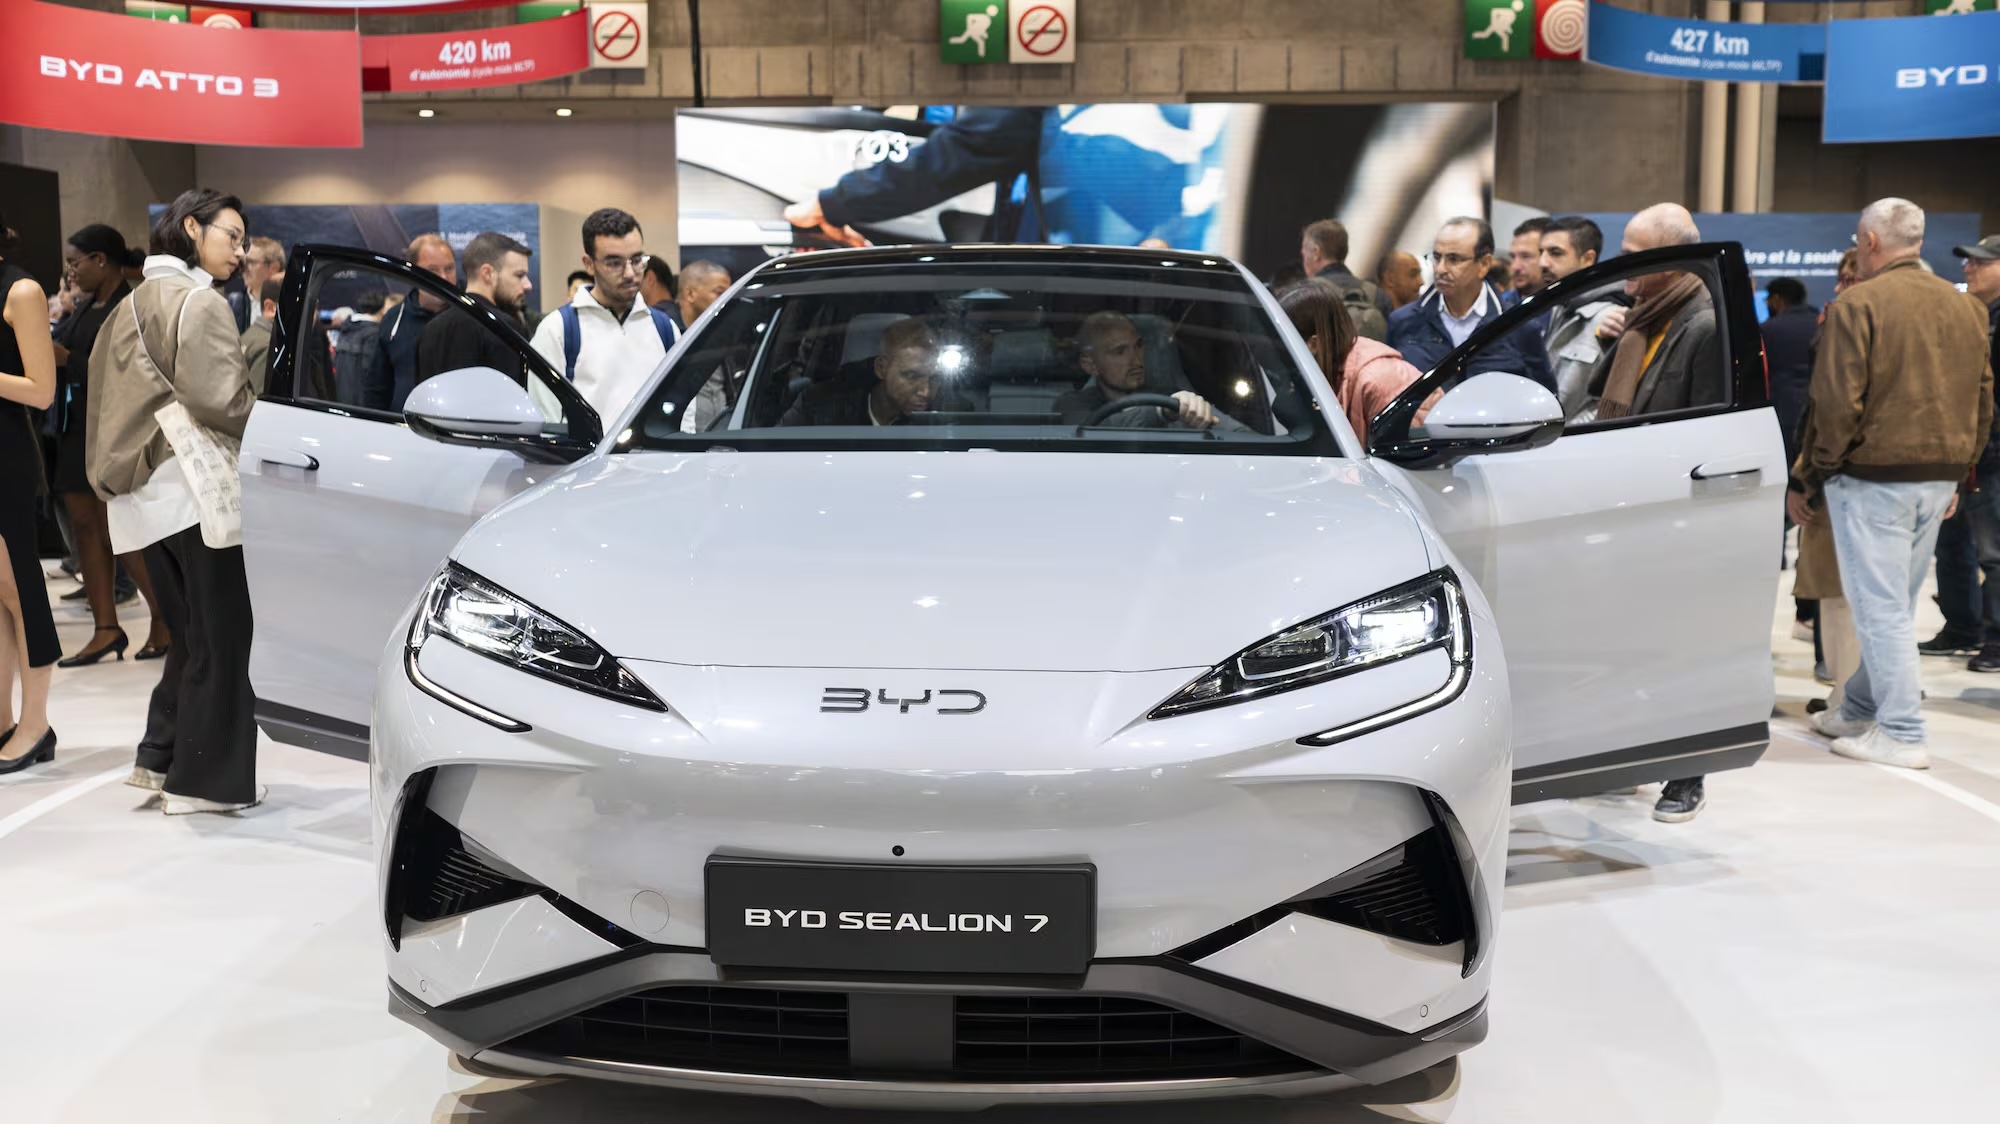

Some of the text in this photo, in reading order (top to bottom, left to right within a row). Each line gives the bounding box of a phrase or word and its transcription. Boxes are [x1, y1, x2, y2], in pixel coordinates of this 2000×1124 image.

[439, 39, 511, 64] 420 km
[1670, 27, 1749, 55] 427 km
[1645, 51, 1700, 67] d'autonomie
[40, 55, 279, 98] BYD ATTO 3
[409, 68, 470, 81] d'autonomie
[1896, 64, 1987, 89] BYD
[1768, 249, 1785, 264] et
[1786, 249, 1801, 264] la
[819, 687, 987, 715] BYD
[744, 907, 1049, 933] BYD SEALION 7
